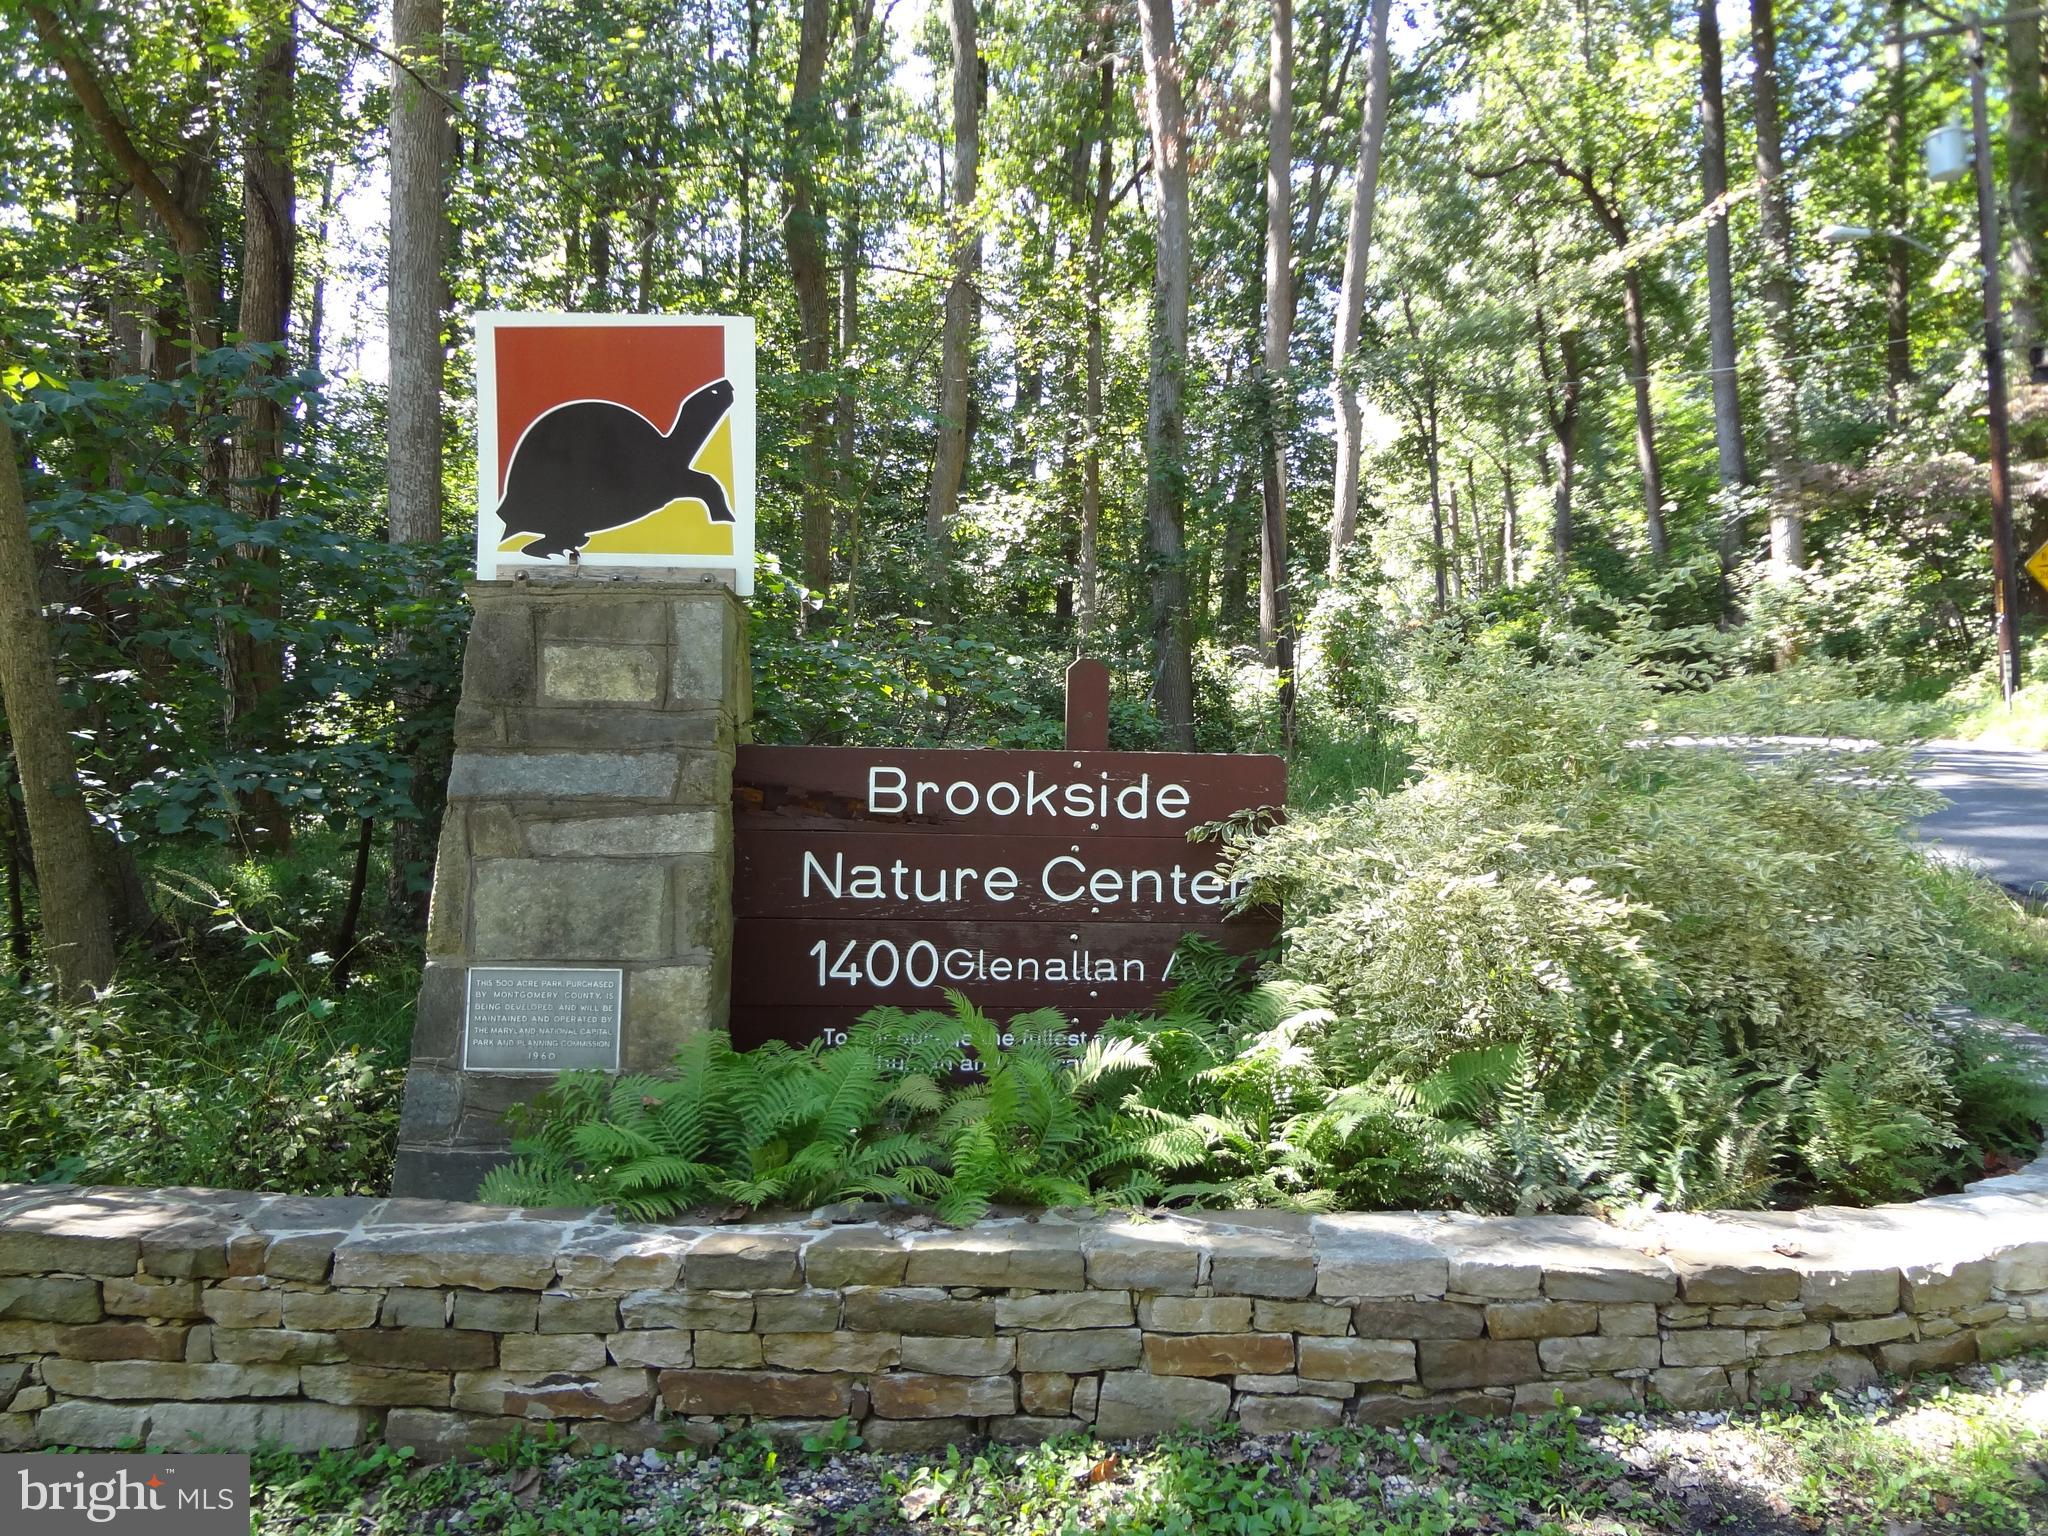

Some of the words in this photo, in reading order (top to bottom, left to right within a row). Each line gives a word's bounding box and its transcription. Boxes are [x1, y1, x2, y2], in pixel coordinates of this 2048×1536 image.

[868, 766, 1190, 820] Brookside
[803, 850, 1019, 902] Nature
[809, 939, 939, 988] 1400
[943, 948, 1145, 982] Glenallan
[476, 979, 493, 987] THIS
[495, 979, 514, 987] 500
[516, 980, 539, 988] ACRE
[565, 980, 614, 989] PURCHASED
[493, 991, 558, 999] MONTGOMERY
[606, 992, 614, 1000] IS
[504, 1003, 553, 1011] DEVELOPED
[558, 1004, 577, 1012] AND
[580, 1004, 599, 1012] WILL
[602, 1004, 614, 1012] BE
[531, 1015, 550, 1023] AND
[553, 1015, 598, 1023] OPERATED
[474, 1026, 489, 1034] THE
[538, 1027, 578, 1035] NATIONAL
[579, 1028, 613, 1036] CAPITAL
[472, 1038, 494, 1046] PARK
[497, 1039, 515, 1047] AND
[517, 1039, 559, 1047] PLANNING
[560, 1040, 612, 1048] COMMISSION
[528, 1051, 556, 1060] 1960
